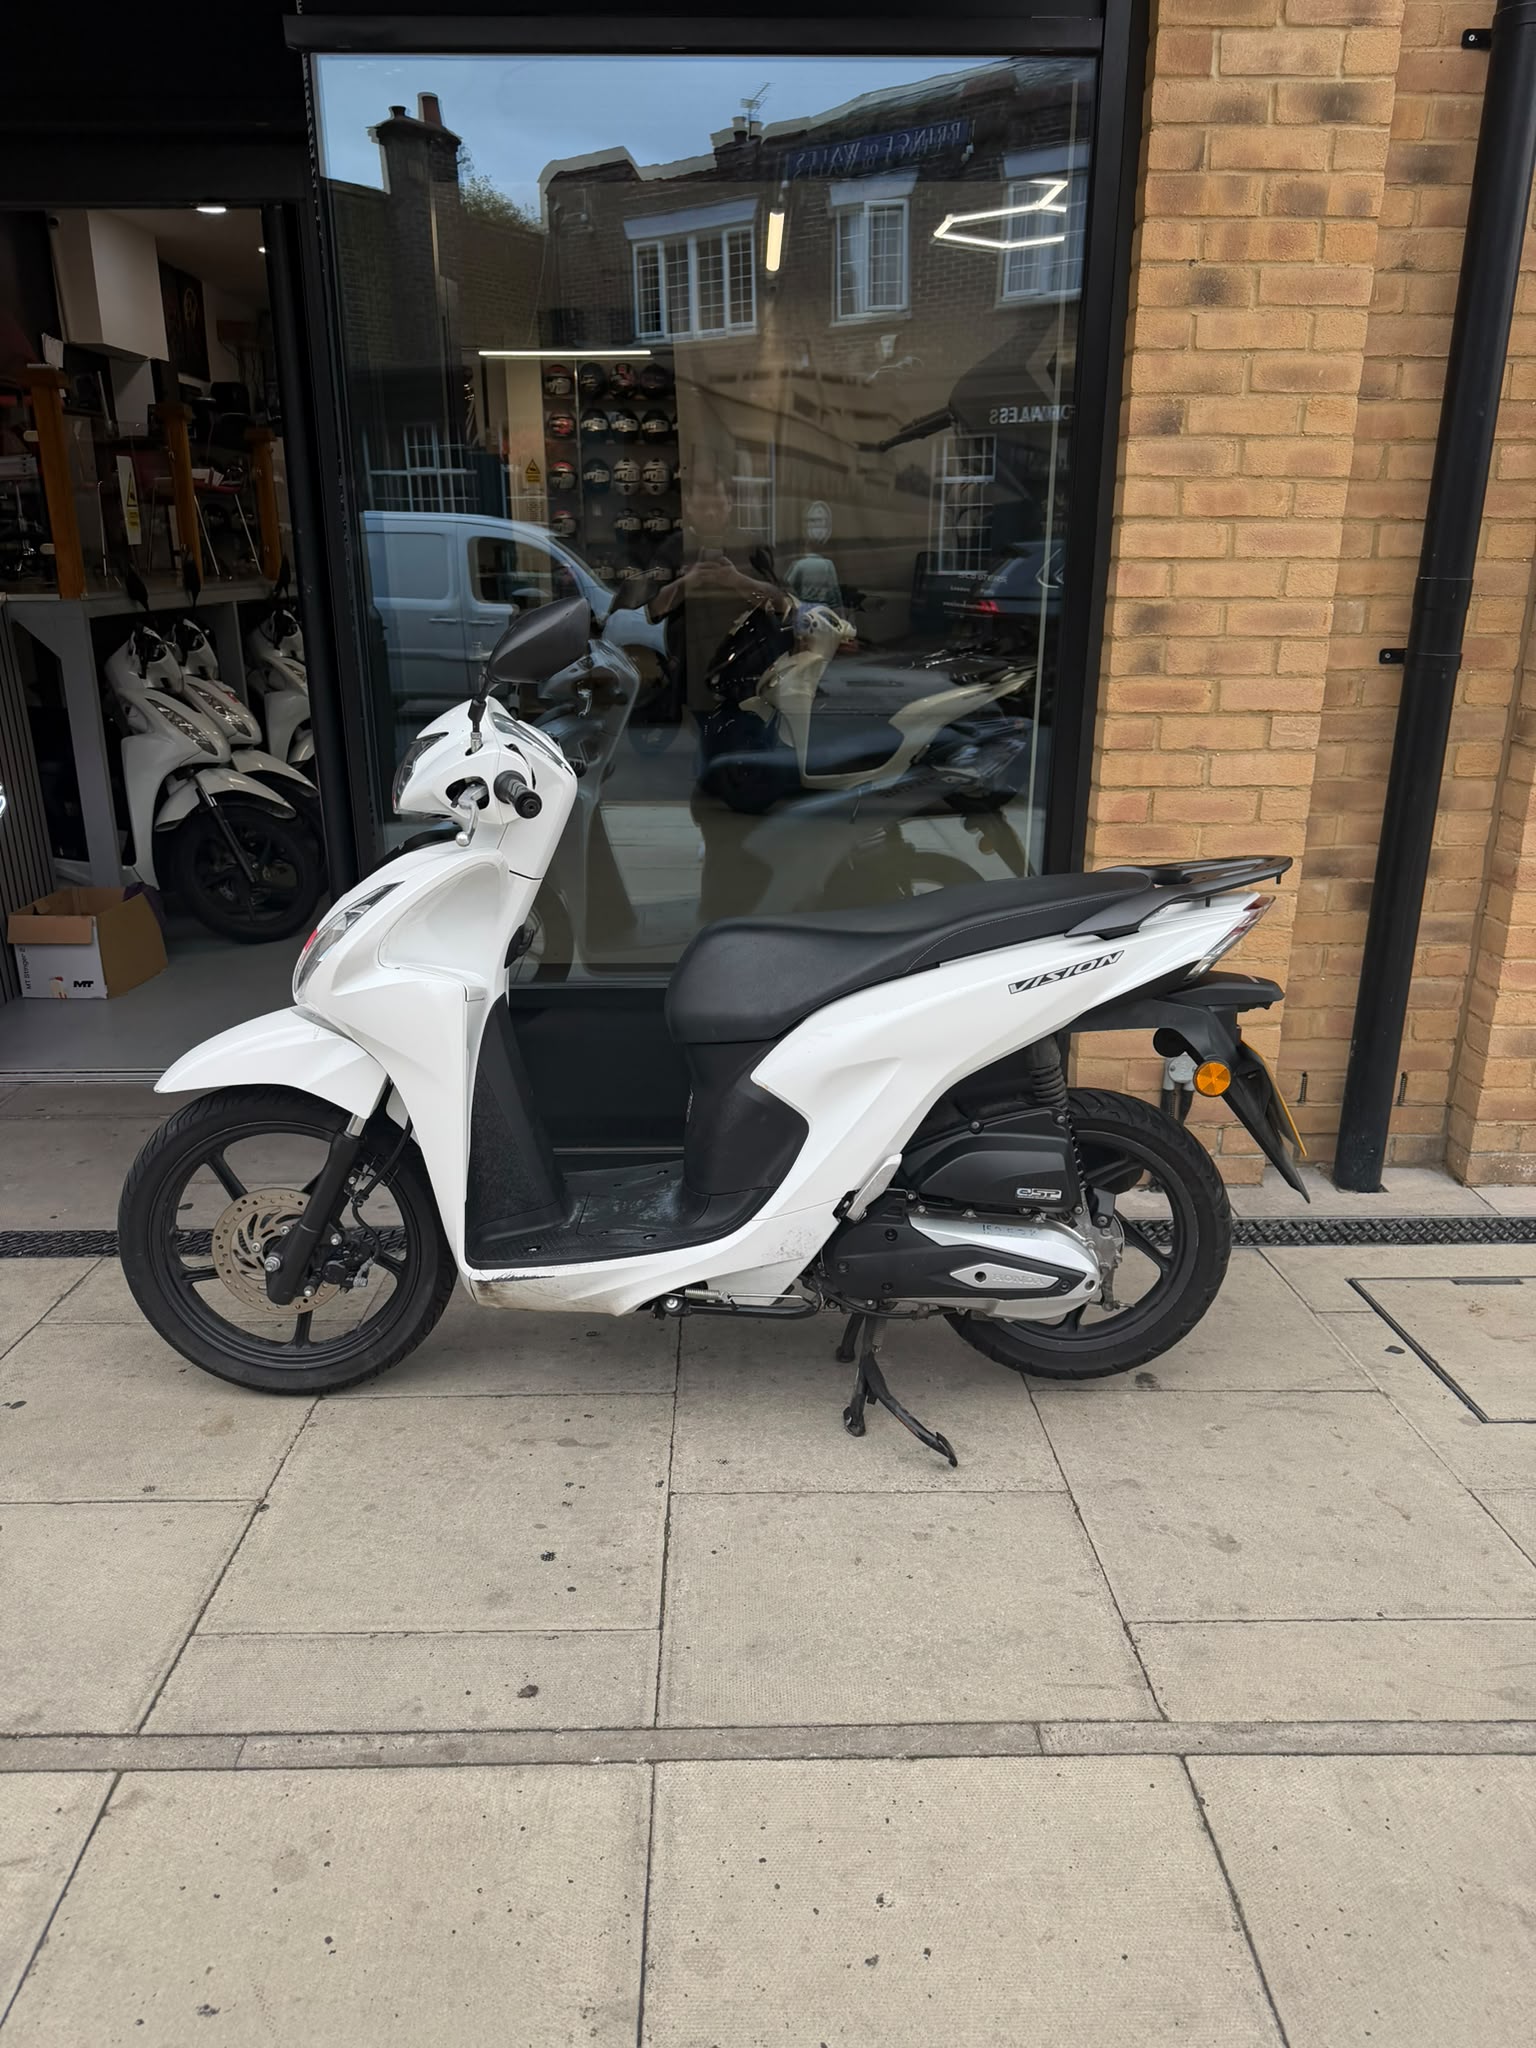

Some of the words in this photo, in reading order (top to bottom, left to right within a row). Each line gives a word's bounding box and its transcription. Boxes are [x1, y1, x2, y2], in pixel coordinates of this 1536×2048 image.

[1008, 950, 1125, 994] VISION
[73, 980, 94, 988] MT
[992, 1273, 1045, 1286] HONDA
